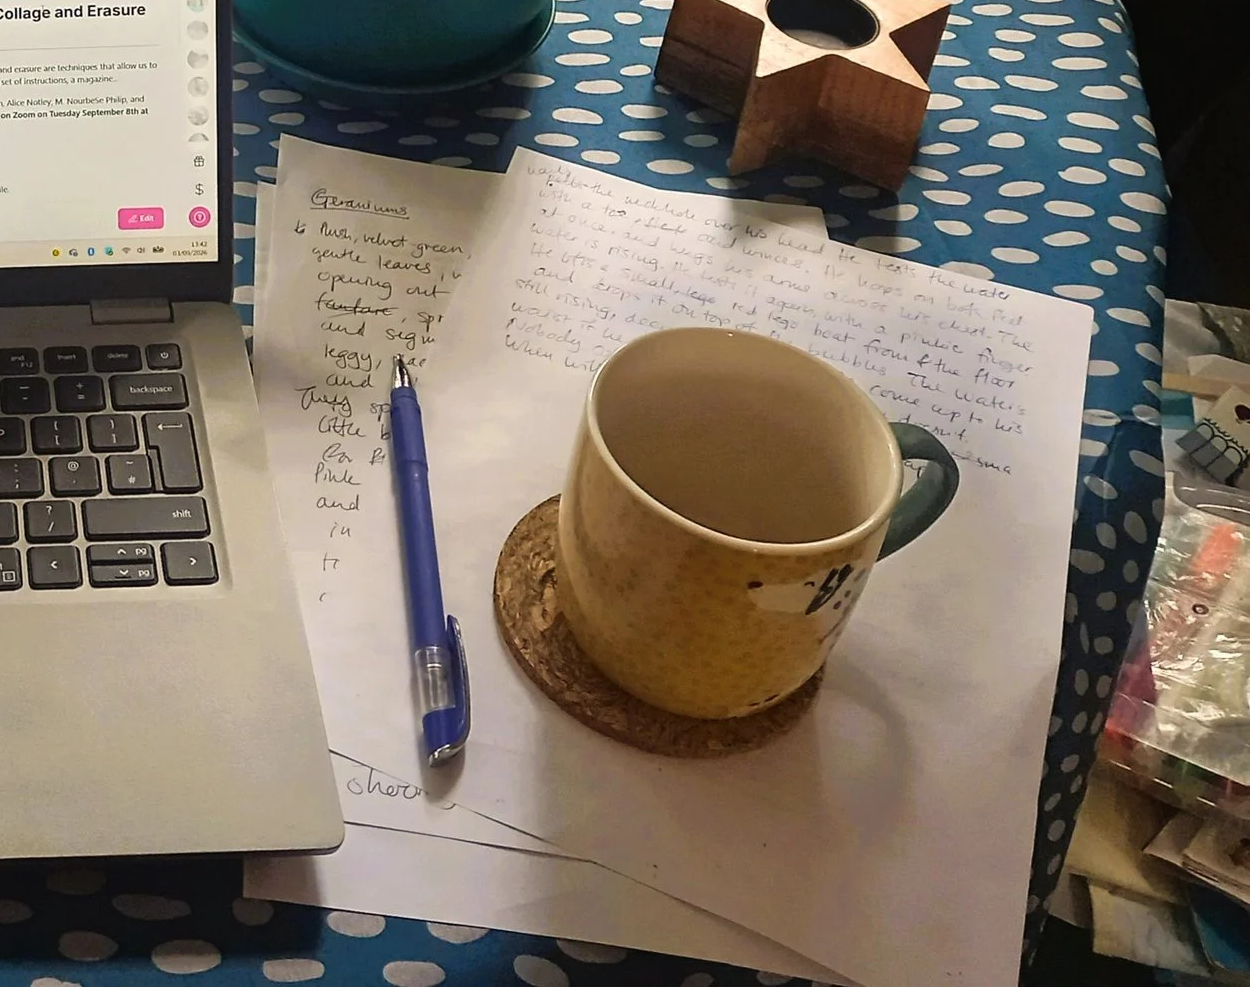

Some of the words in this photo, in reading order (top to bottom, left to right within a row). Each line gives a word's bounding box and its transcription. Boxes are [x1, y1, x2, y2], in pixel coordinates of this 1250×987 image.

[54, 5, 83, 18] and
[87, 4, 146, 17] Erasure
[1, 112, 11, 120] on
[12, 110, 36, 119] Zoom
[49, 109, 80, 119] Tuesday
[82, 107, 124, 118] September
[126, 107, 139, 115] 8th
[140, 107, 149, 115] at
[129, 384, 173, 394] backspace
[172, 509, 192, 518] shift
